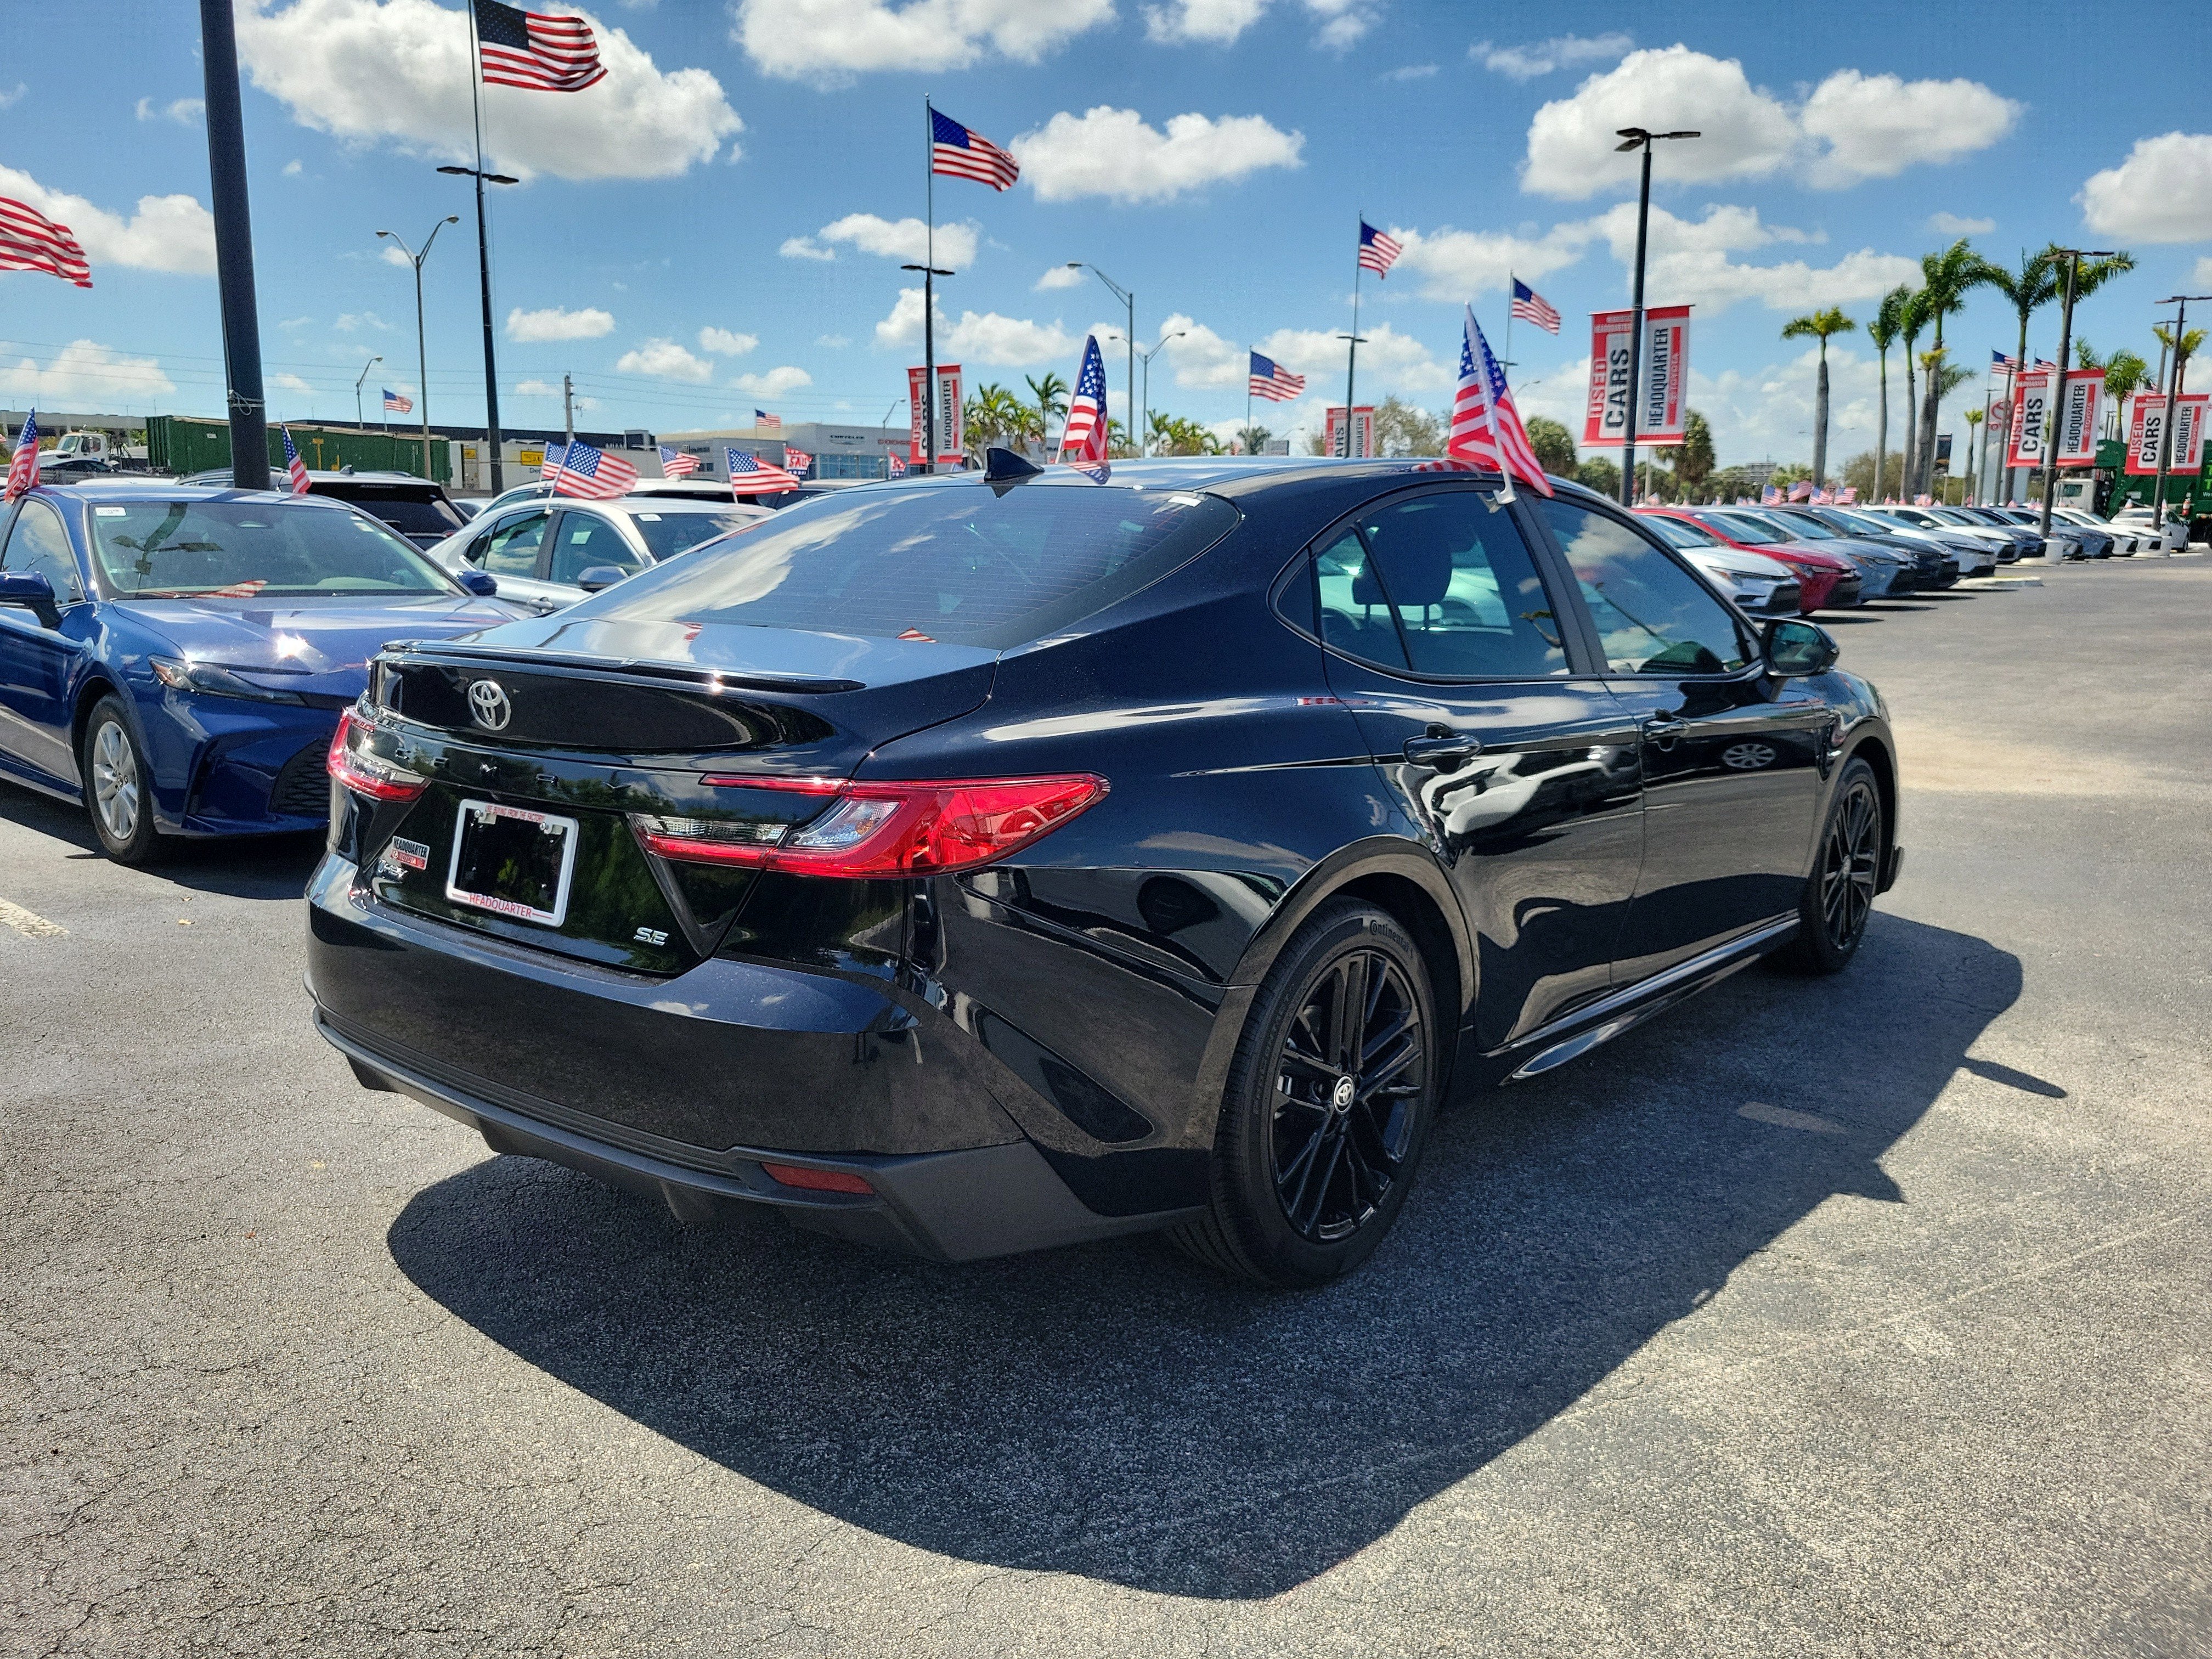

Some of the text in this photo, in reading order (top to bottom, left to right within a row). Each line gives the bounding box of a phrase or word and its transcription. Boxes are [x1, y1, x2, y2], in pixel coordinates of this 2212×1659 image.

[1588, 359, 1606, 418] USED
[1605, 348, 1629, 428] CARS
[1648, 328, 1668, 426] HEADQUARTER
[913, 402, 921, 441] USED
[943, 380, 952, 449] HEADQUARTER
[2009, 404, 2024, 444] USED
[2022, 398, 2043, 452] CARS
[2066, 384, 2086, 453] HEADQUARTER
[2175, 406, 2193, 464] HEADQUARTER
[1335, 427, 1345, 456] ARS
[2130, 422, 2144, 456] USED
[2142, 416, 2161, 462] CARS
[394, 837, 428, 857] HEADQUARTER
[469, 893, 532, 918] HEADQUARTER
[634, 927, 669, 946] SE
